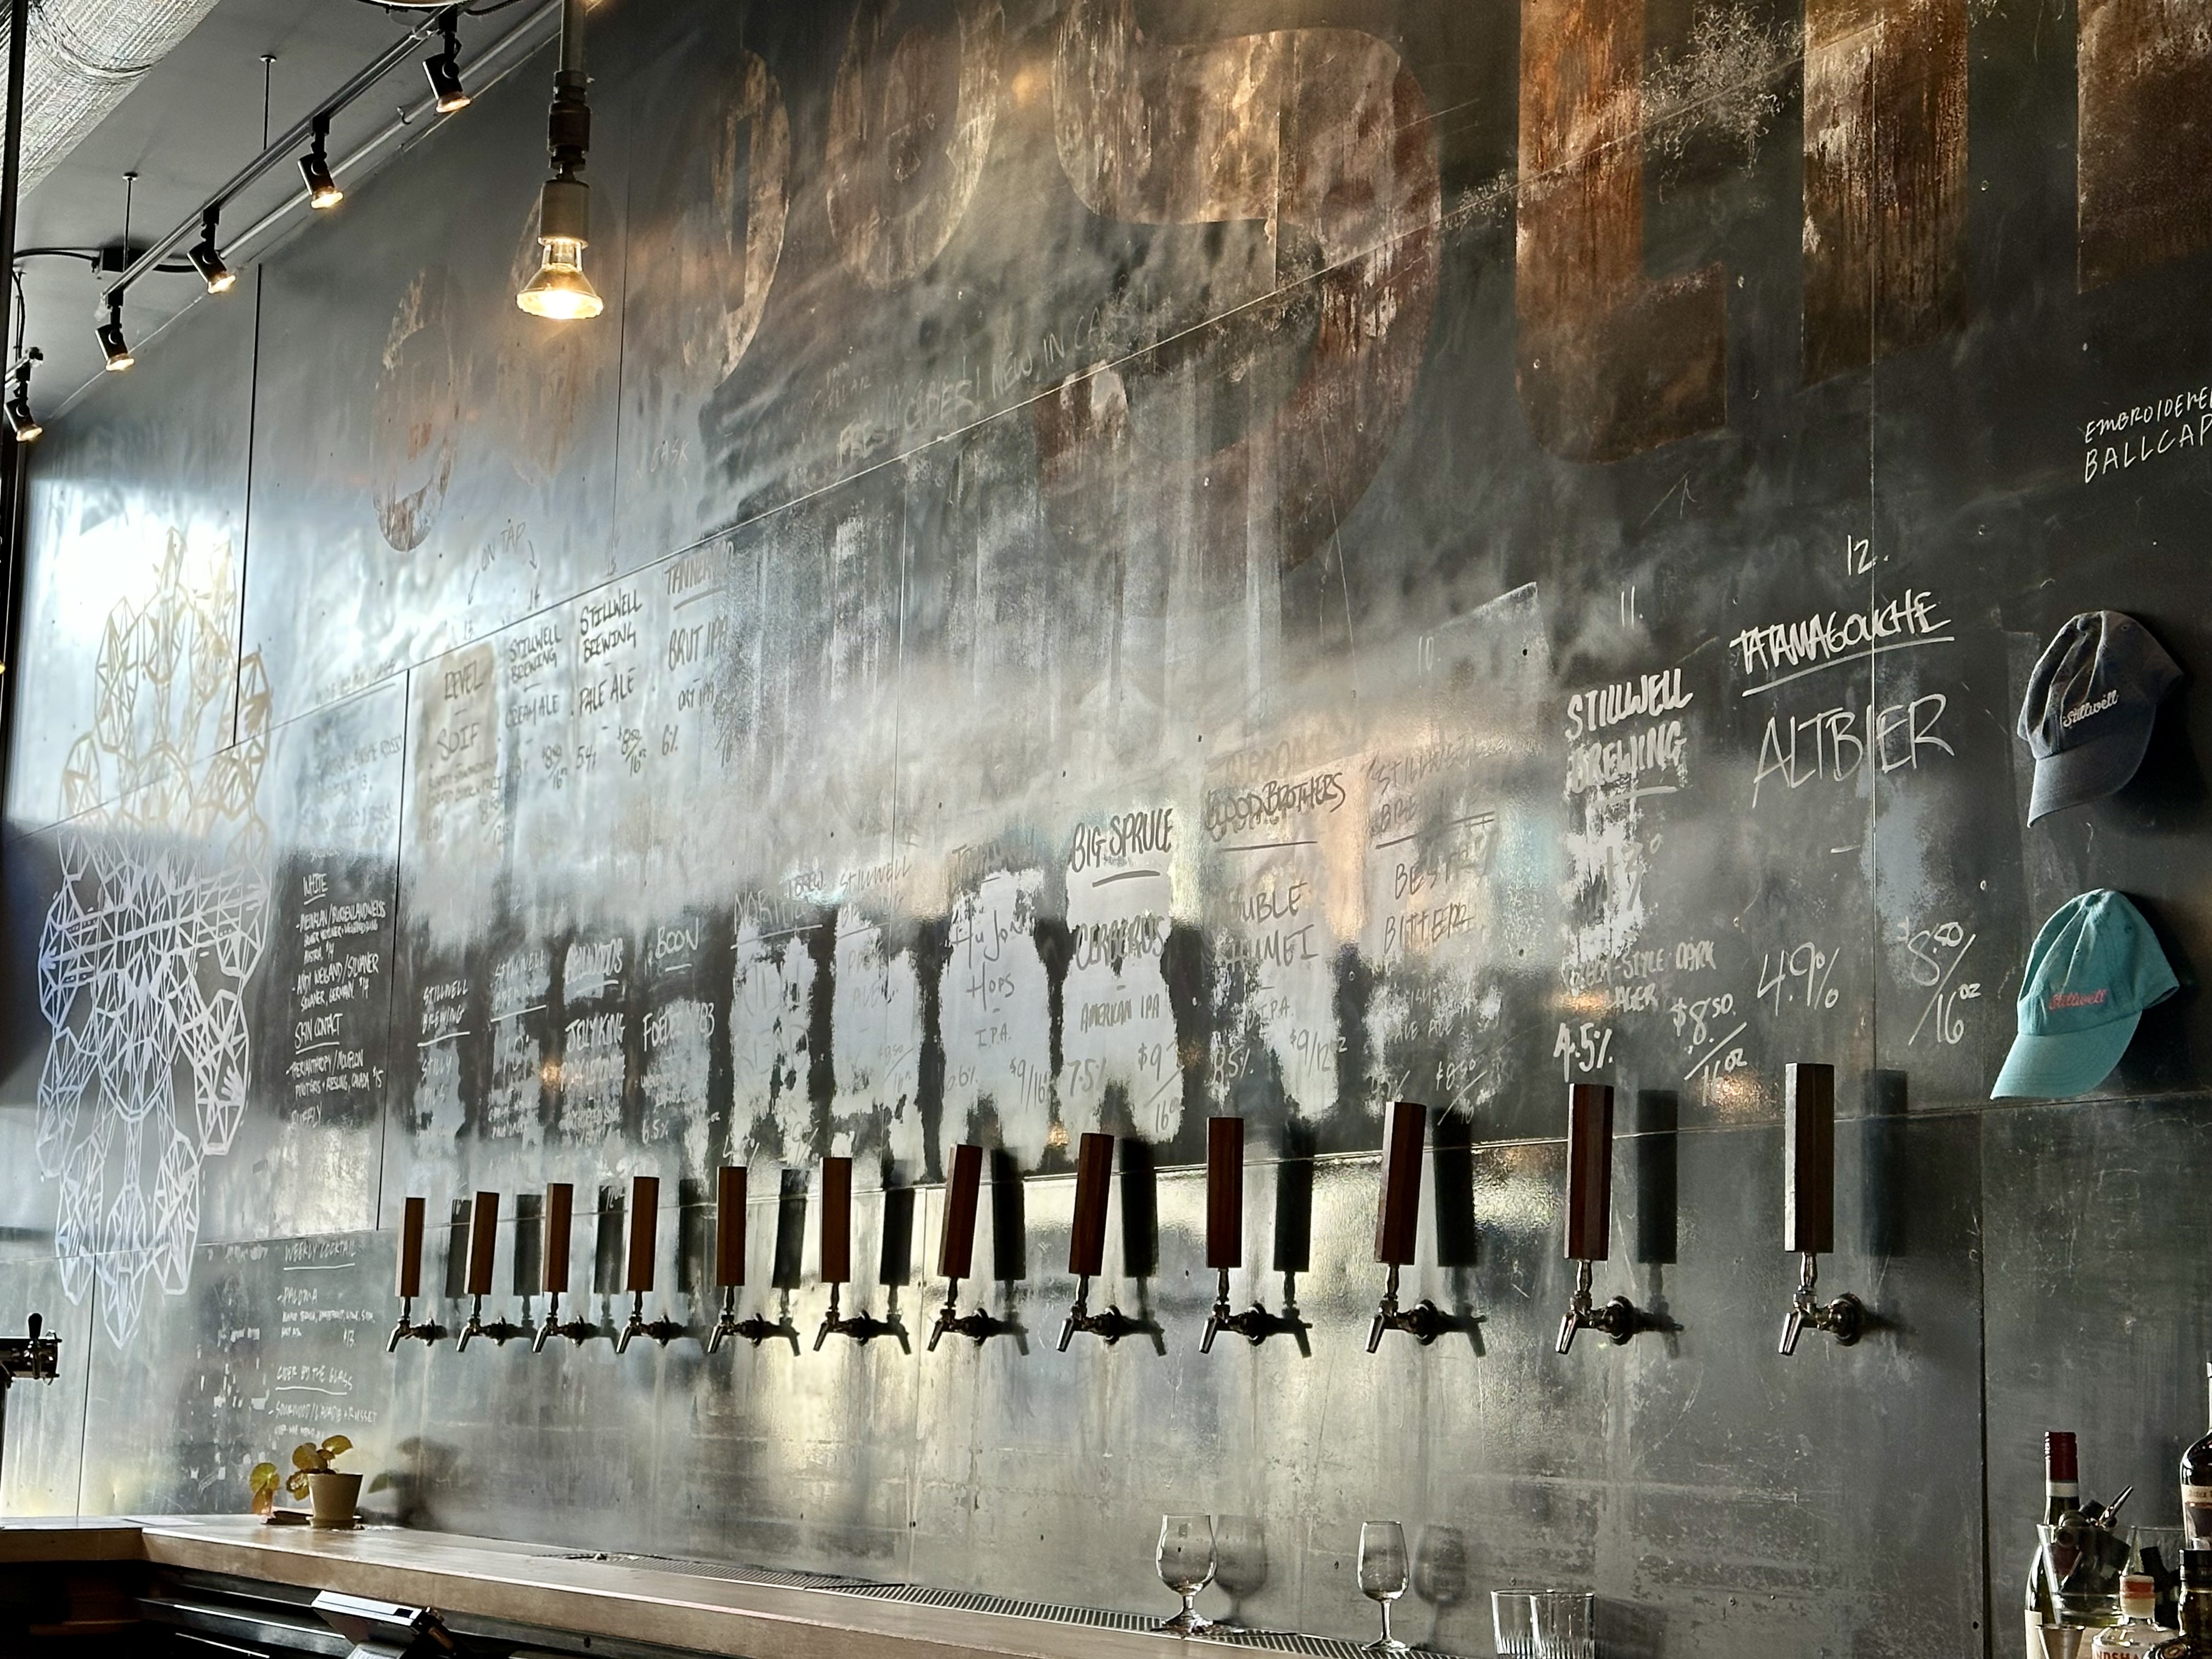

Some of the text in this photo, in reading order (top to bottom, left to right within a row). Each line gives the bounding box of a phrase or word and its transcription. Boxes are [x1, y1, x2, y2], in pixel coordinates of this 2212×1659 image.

[2085, 386, 2212, 443] EMBROIDERE
[481, 522, 526, 571] ON TAP
[579, 587, 643, 636] STILLWELL
[1729, 588, 1953, 674] TATAMAGOUCHE
[509, 623, 562, 664] STILLWELL
[583, 620, 637, 664] BREWING
[668, 624, 704, 672] BRUT
[444, 659, 484, 701] REVEL
[510, 647, 558, 684] BREWING
[538, 694, 559, 717] ALE
[579, 666, 637, 718] PALE ALE
[1565, 667, 1694, 740] STILLWELL
[2062, 689, 2120, 729] Stillwell
[437, 721, 481, 761] SOIF
[1752, 693, 1955, 809] ALTBIER
[1261, 772, 1346, 817] BROTHERS
[1071, 822, 1106, 872] BIG
[1109, 808, 1174, 858] SPRUCE
[302, 873, 329, 897] WHITE
[655, 917, 699, 960] BOON
[1076, 915, 1166, 970] CERBERUS
[1675, 940, 1718, 970] DARK
[422, 978, 469, 1007] STILLWELL
[1141, 993, 1160, 1019] IPA
[2048, 989, 2108, 1011] Stillwell
[314, 1012, 344, 1038] CONTACT
[421, 1003, 465, 1035] BREWING
[421, 1055, 453, 1081] STILLY
[284, 1240, 318, 1263] WEEKLY
[320, 1239, 357, 1259] COCKTAIL
